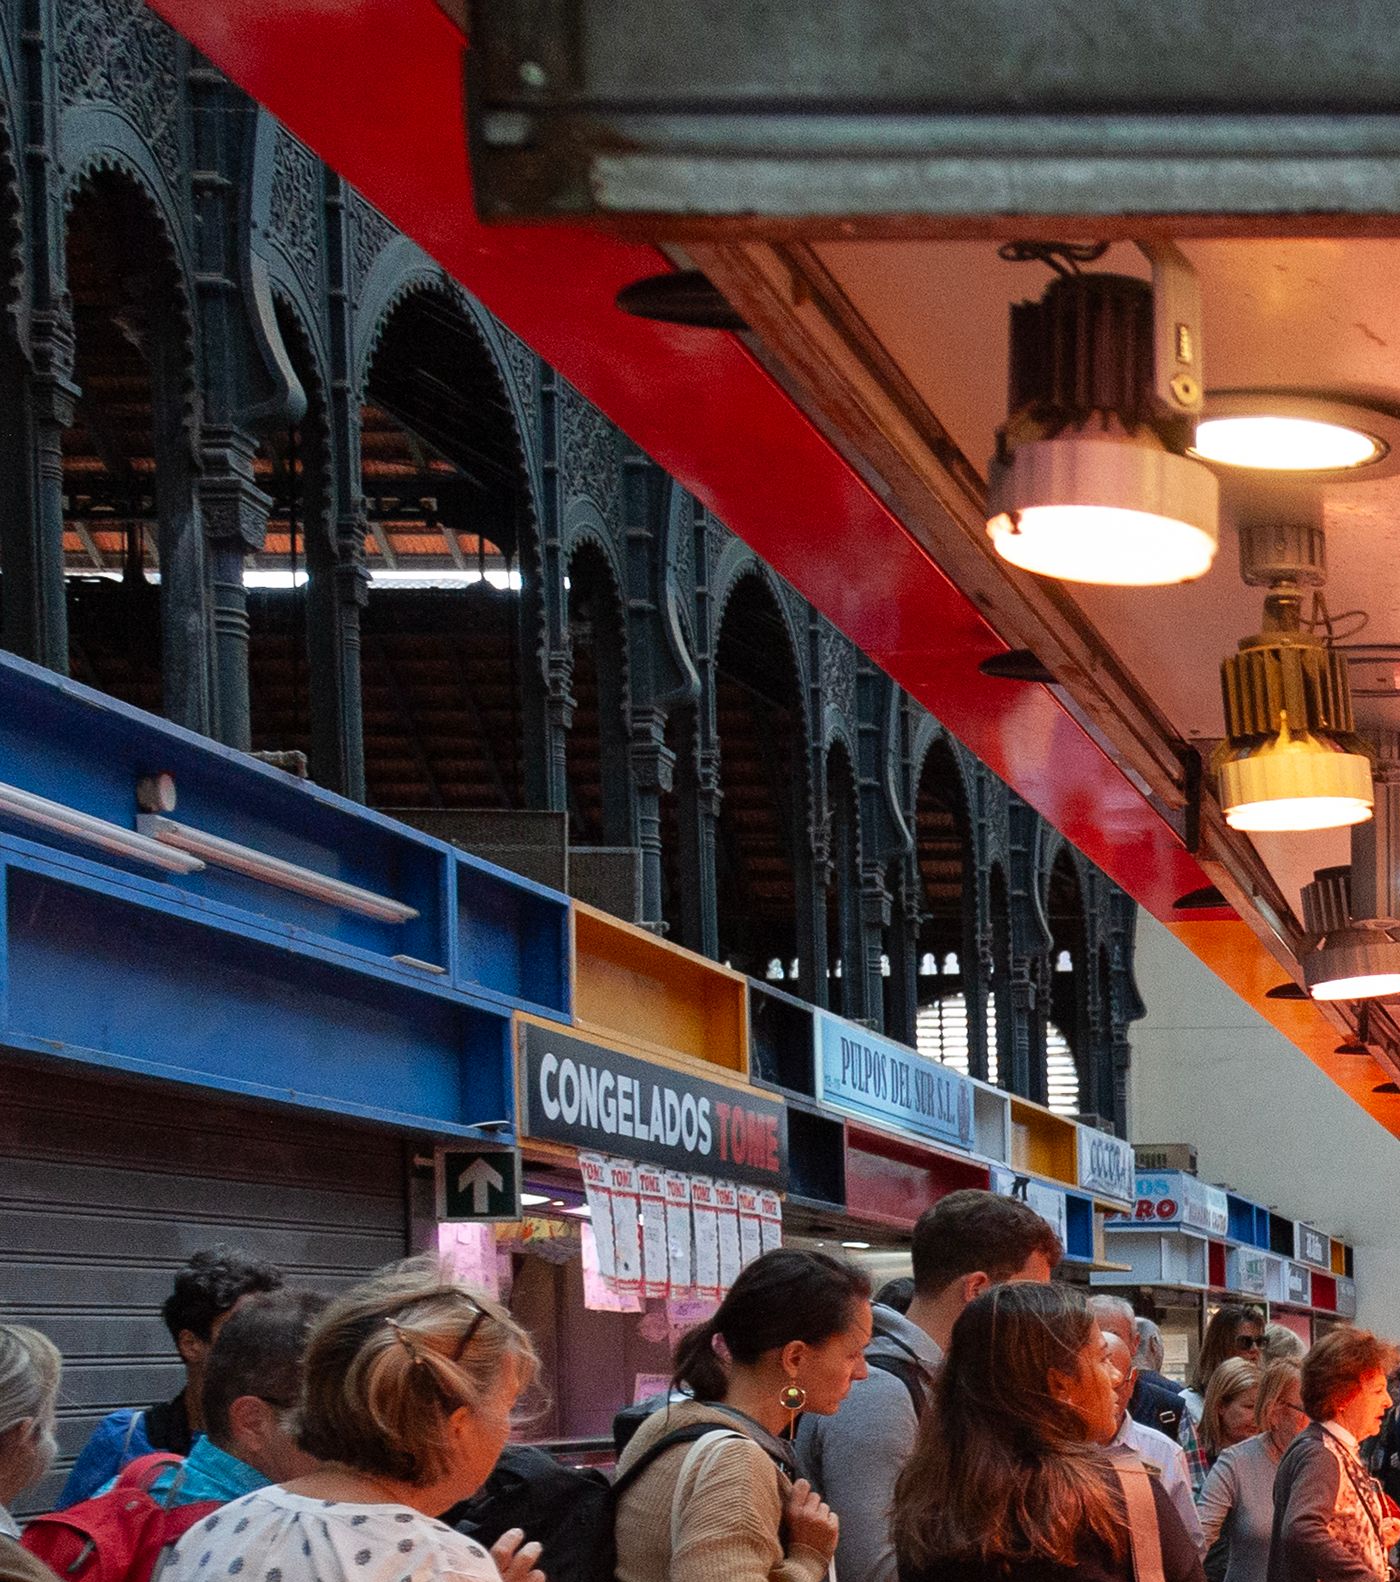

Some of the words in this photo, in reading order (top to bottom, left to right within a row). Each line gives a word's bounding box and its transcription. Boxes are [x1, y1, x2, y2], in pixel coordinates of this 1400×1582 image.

[539, 1052, 713, 1157] CONGELADOS
[716, 1101, 781, 1173] TOME
[840, 1036, 887, 1100] PULPOS
[890, 1058, 912, 1109] DEL
[915, 1068, 935, 1118] SUR
